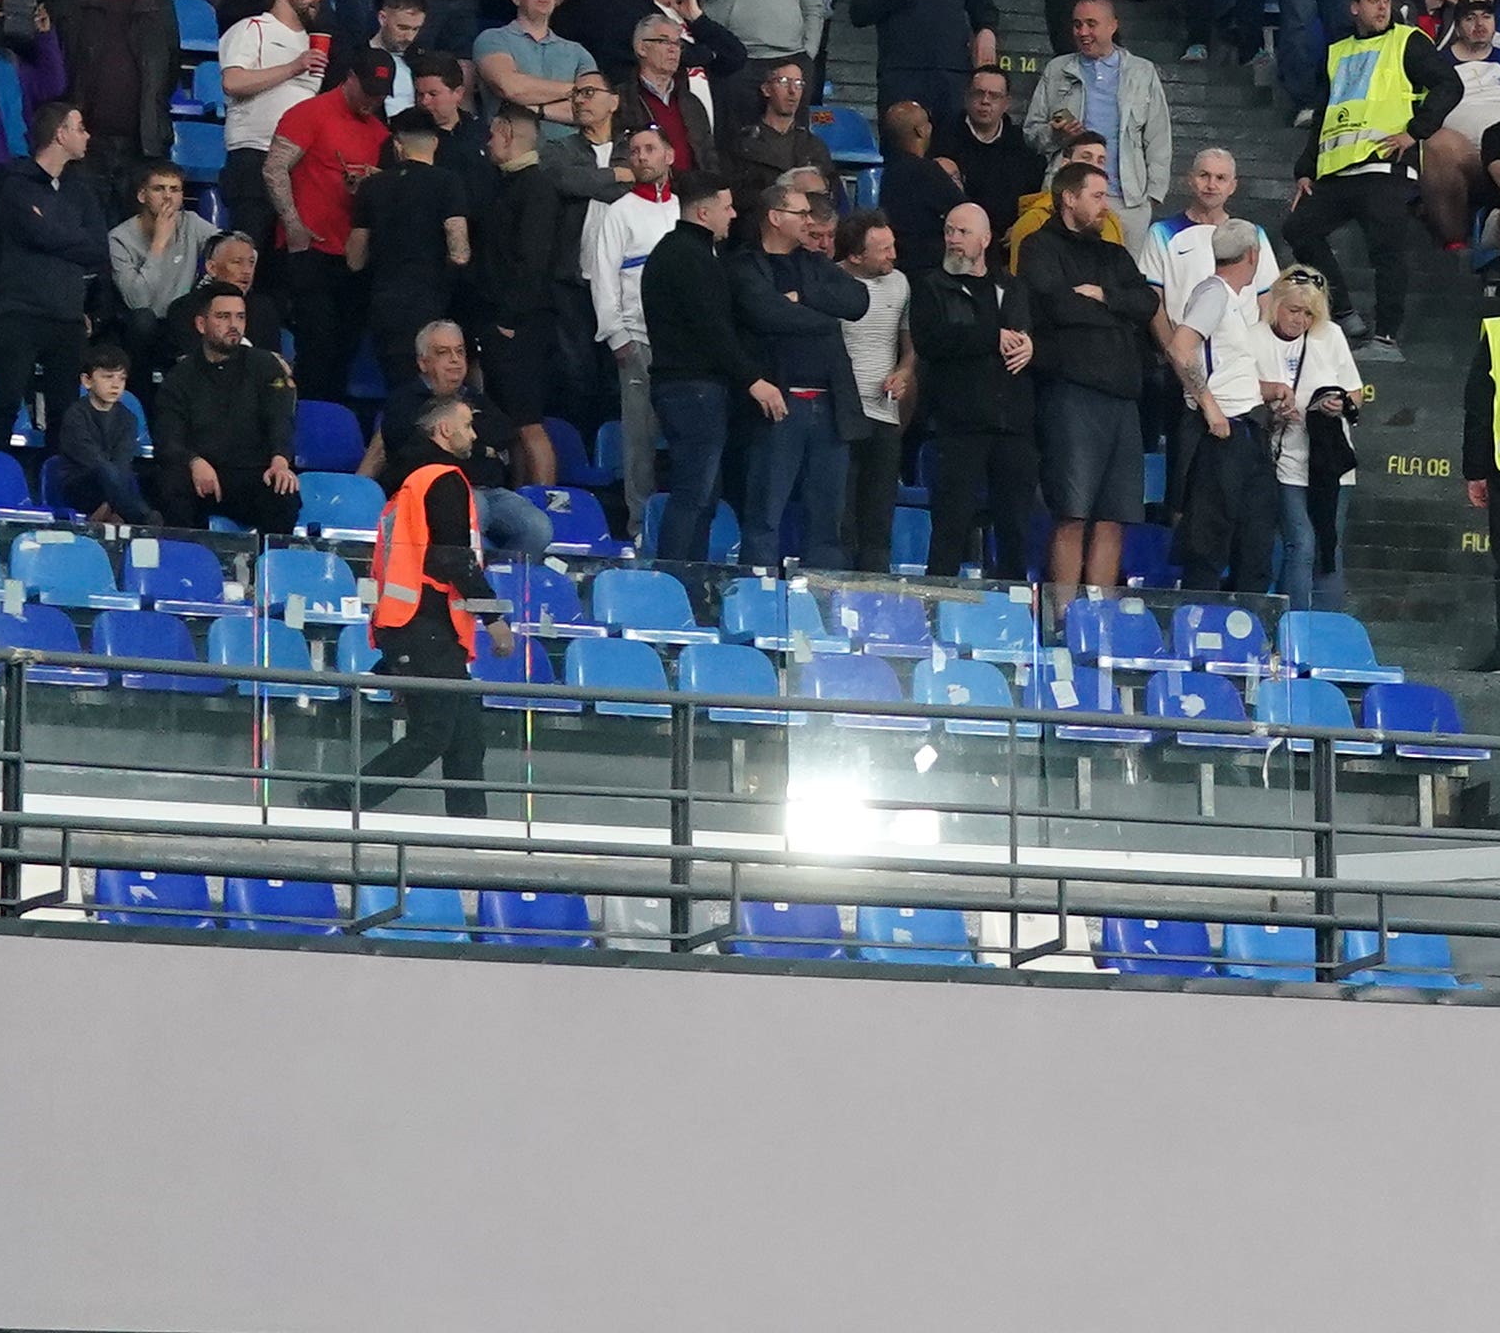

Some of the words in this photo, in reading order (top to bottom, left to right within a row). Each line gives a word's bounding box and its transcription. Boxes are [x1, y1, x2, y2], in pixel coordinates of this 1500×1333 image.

[1019, 55, 1037, 74] 14
[1387, 455, 1423, 476] FILA
[1427, 457, 1451, 476] 08
